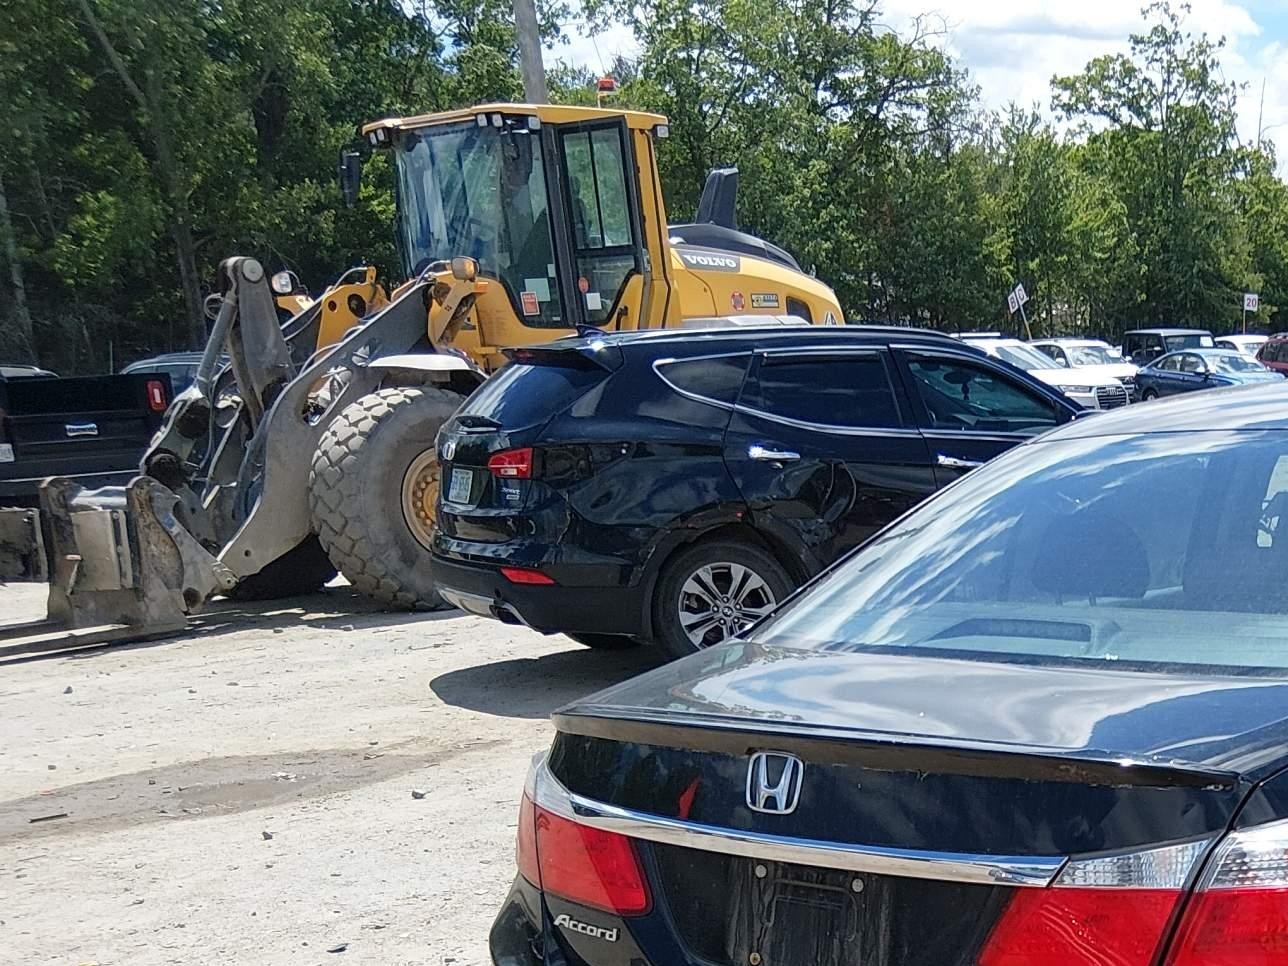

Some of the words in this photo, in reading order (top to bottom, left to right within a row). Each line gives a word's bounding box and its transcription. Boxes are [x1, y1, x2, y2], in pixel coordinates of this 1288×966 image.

[682, 254, 737, 268] VOLVO
[1246, 297, 1257, 308] 20
[553, 914, 618, 942] Accord
